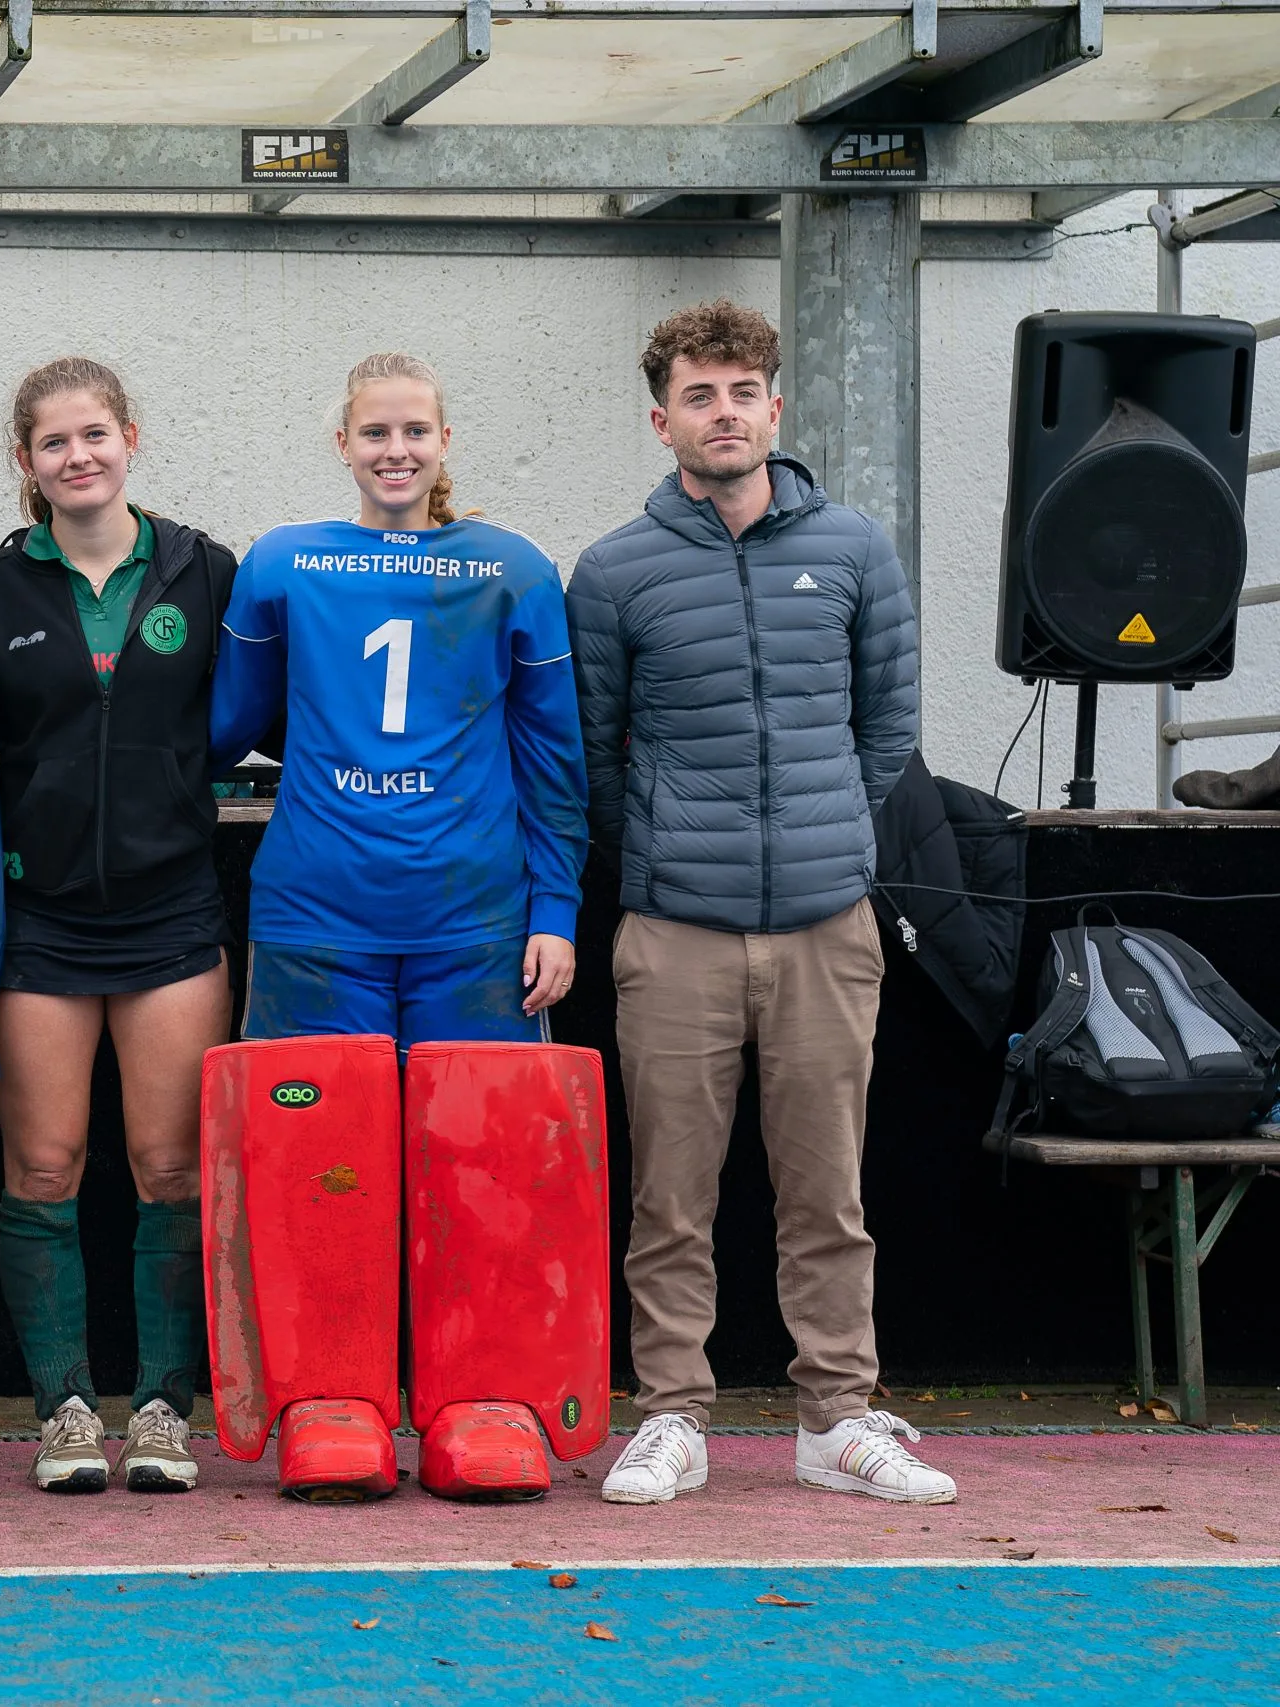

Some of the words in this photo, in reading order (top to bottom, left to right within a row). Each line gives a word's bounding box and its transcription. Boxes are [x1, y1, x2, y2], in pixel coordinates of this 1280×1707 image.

[252, 136, 338, 170] EHL
[831, 134, 917, 168] EHL
[383, 532, 419, 545] PECO
[293, 553, 461, 577] HARVESTEHUDER
[466, 560, 504, 578] THC
[363, 618, 413, 733] 1
[334, 766, 434, 795] VÖLKEL
[276, 1088, 315, 1102] OBO
